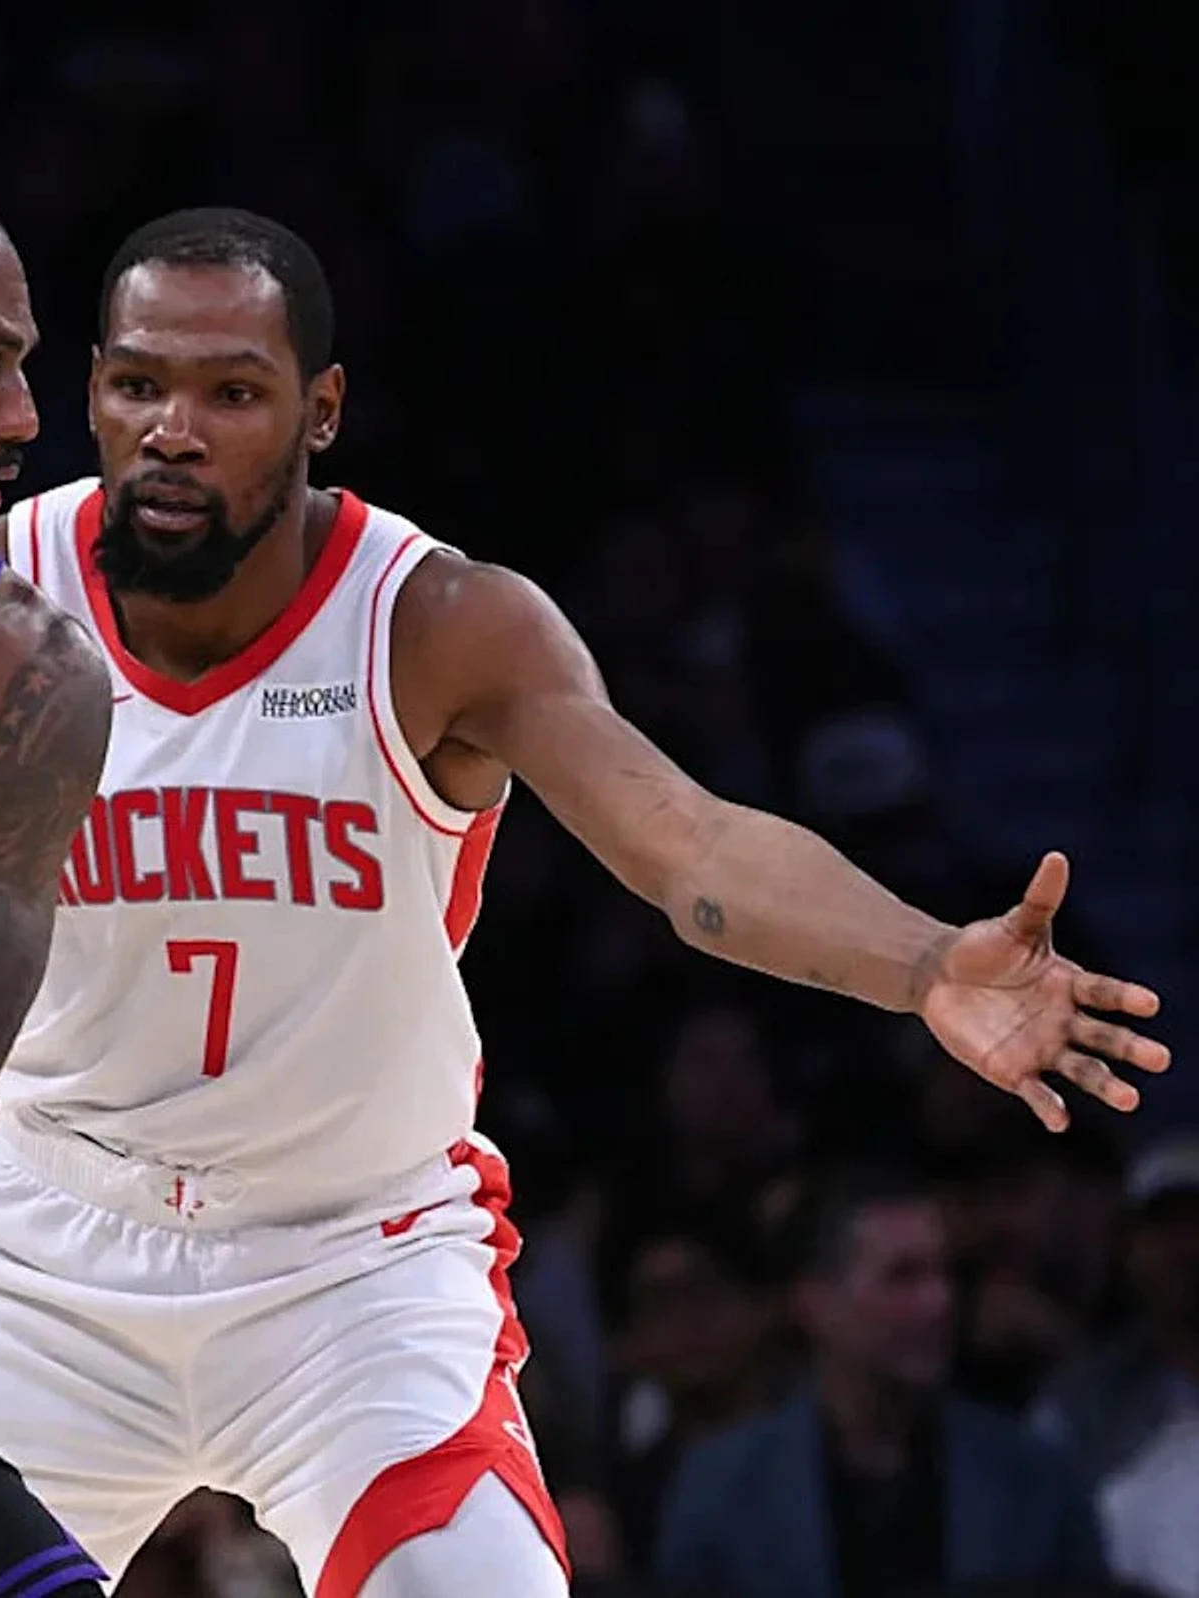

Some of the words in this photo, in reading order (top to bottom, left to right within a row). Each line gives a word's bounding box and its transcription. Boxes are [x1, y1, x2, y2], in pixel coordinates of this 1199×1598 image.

[261, 695, 357, 717] HERMANN
[56, 786, 384, 912] OCKETS
[166, 940, 239, 1078] 7
